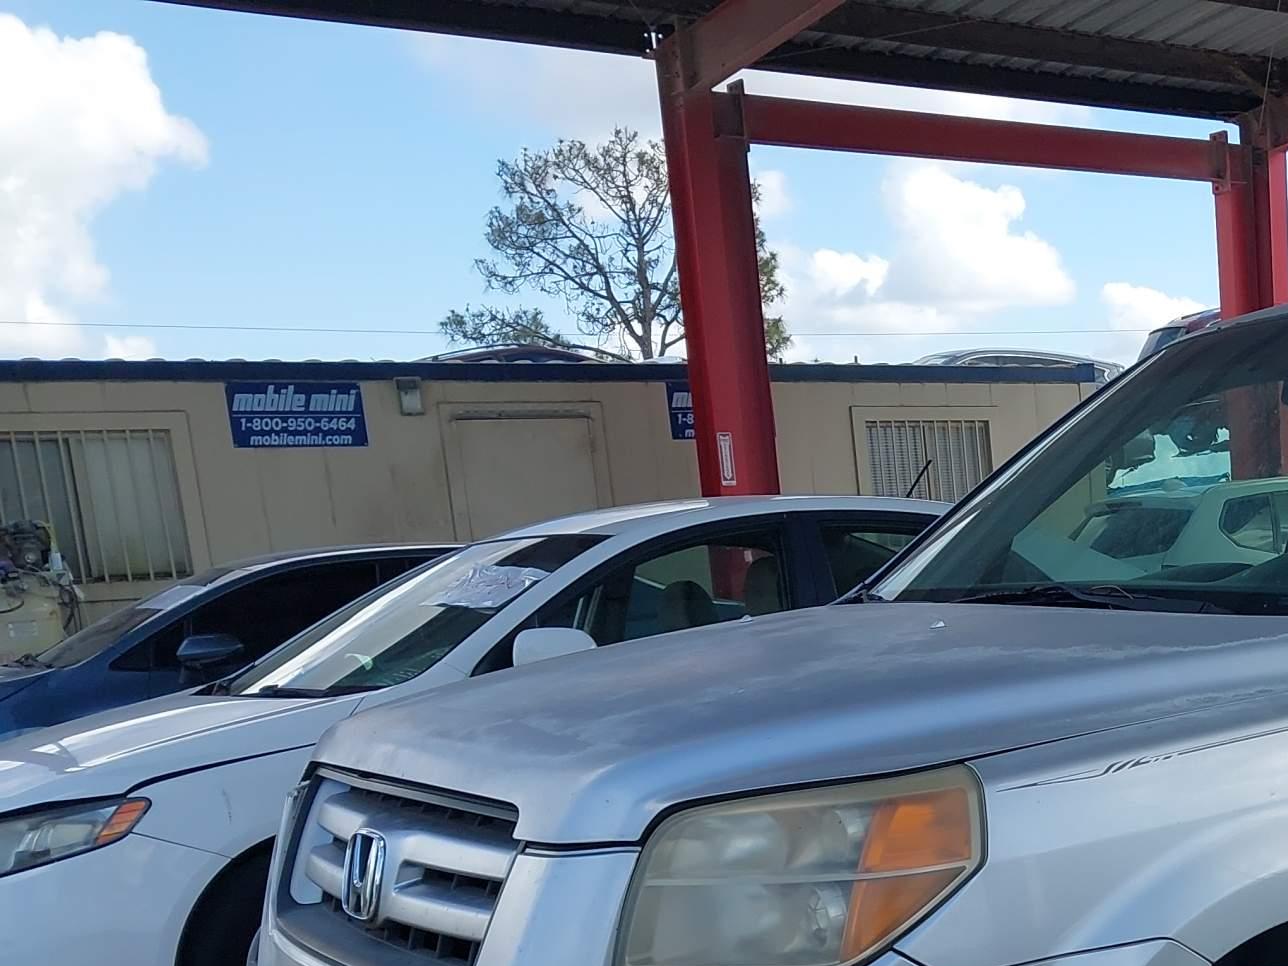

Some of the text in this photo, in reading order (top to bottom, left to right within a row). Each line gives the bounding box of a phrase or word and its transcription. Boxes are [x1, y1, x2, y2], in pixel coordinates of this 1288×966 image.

[232, 385, 358, 411] mobile mini
[240, 418, 356, 431] 1-800-950-6464
[250, 433, 353, 446] mobilemini.com
